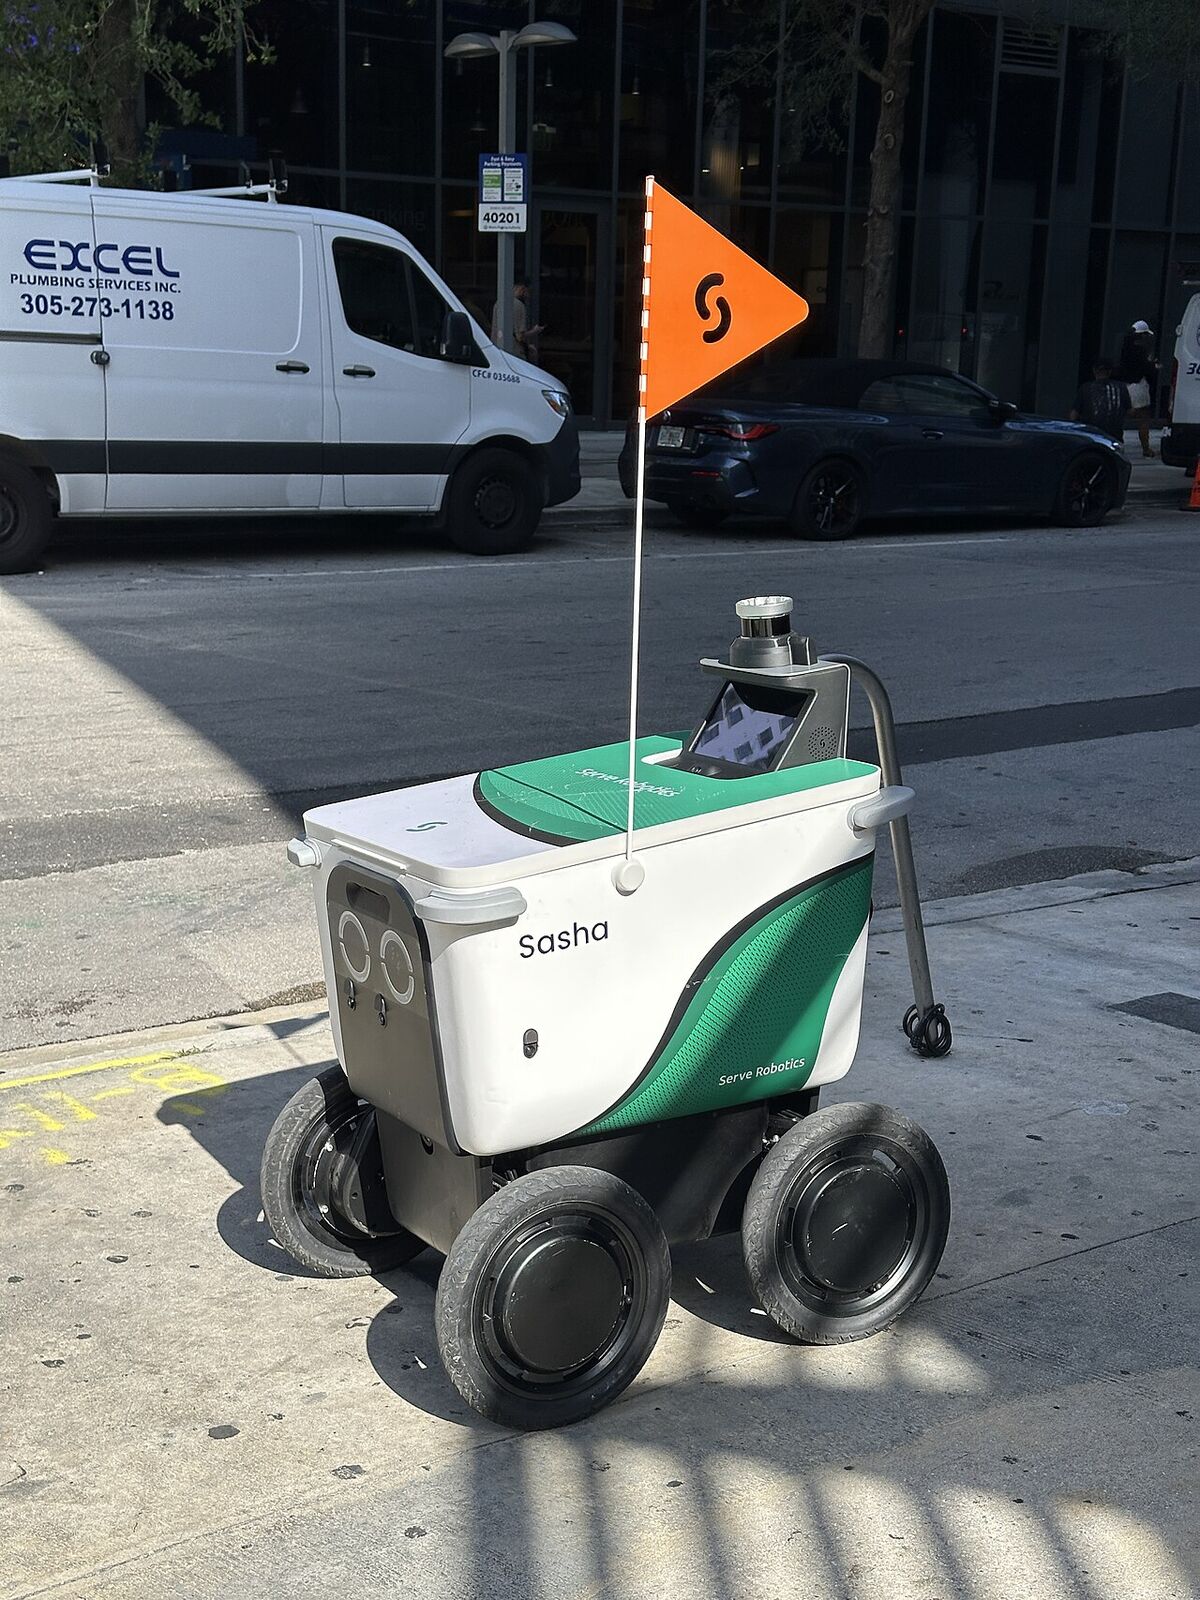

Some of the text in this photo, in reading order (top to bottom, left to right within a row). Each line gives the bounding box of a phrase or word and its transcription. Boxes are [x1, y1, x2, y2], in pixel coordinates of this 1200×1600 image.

[483, 212, 520, 224] 40201
[23, 239, 181, 279] EXCEL
[10, 273, 182, 294] PLUMBING SERVICES INC.
[20, 293, 175, 321] 305-273-1138
[472, 369, 492, 379] CFC#
[519, 921, 609, 959] Sasha
[718, 1058, 806, 1086] Serve Robotics
